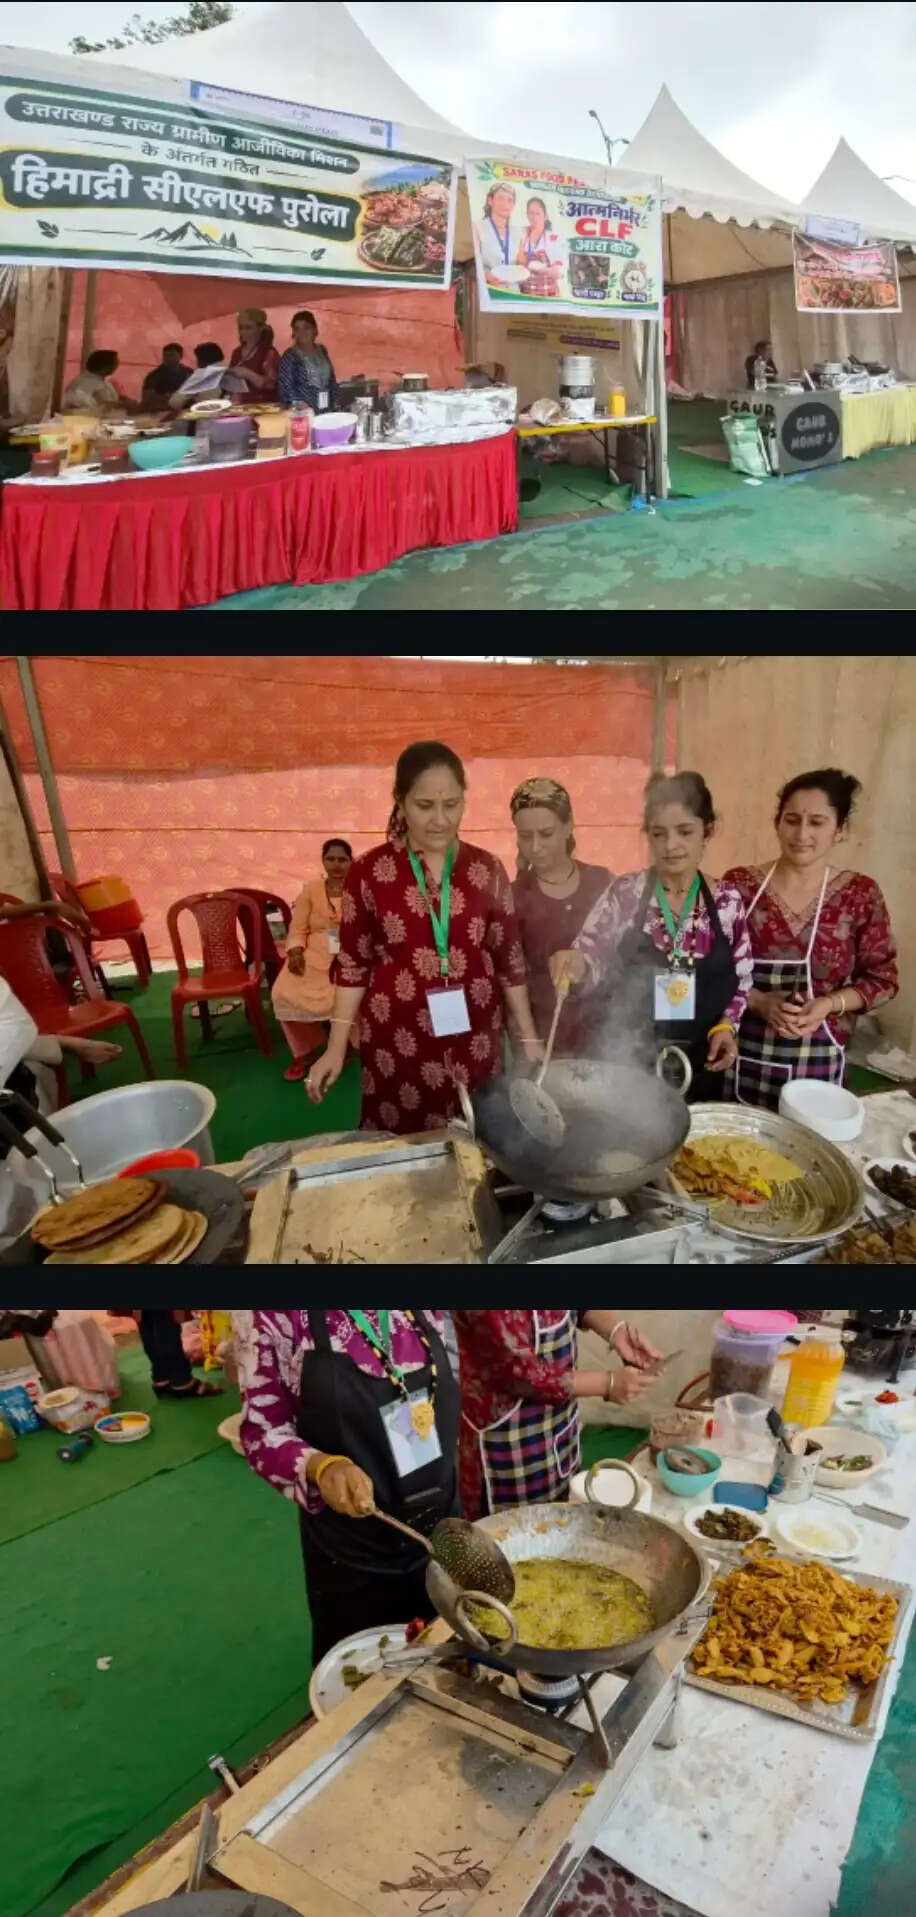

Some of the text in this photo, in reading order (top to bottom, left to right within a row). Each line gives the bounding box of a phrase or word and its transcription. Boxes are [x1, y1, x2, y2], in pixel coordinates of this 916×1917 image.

[21, 101, 116, 127] उत्तराखण्ड
[120, 115, 167, 136] राज्य
[170, 123, 227, 148] ग्रामीण
[231, 136, 306, 162] आजीविका
[140, 141, 261, 177] के अंतर्गत गठित
[11, 153, 351, 229] हिमाद्री सीएलएफ पुरोला
[575, 217, 634, 240] CLF
